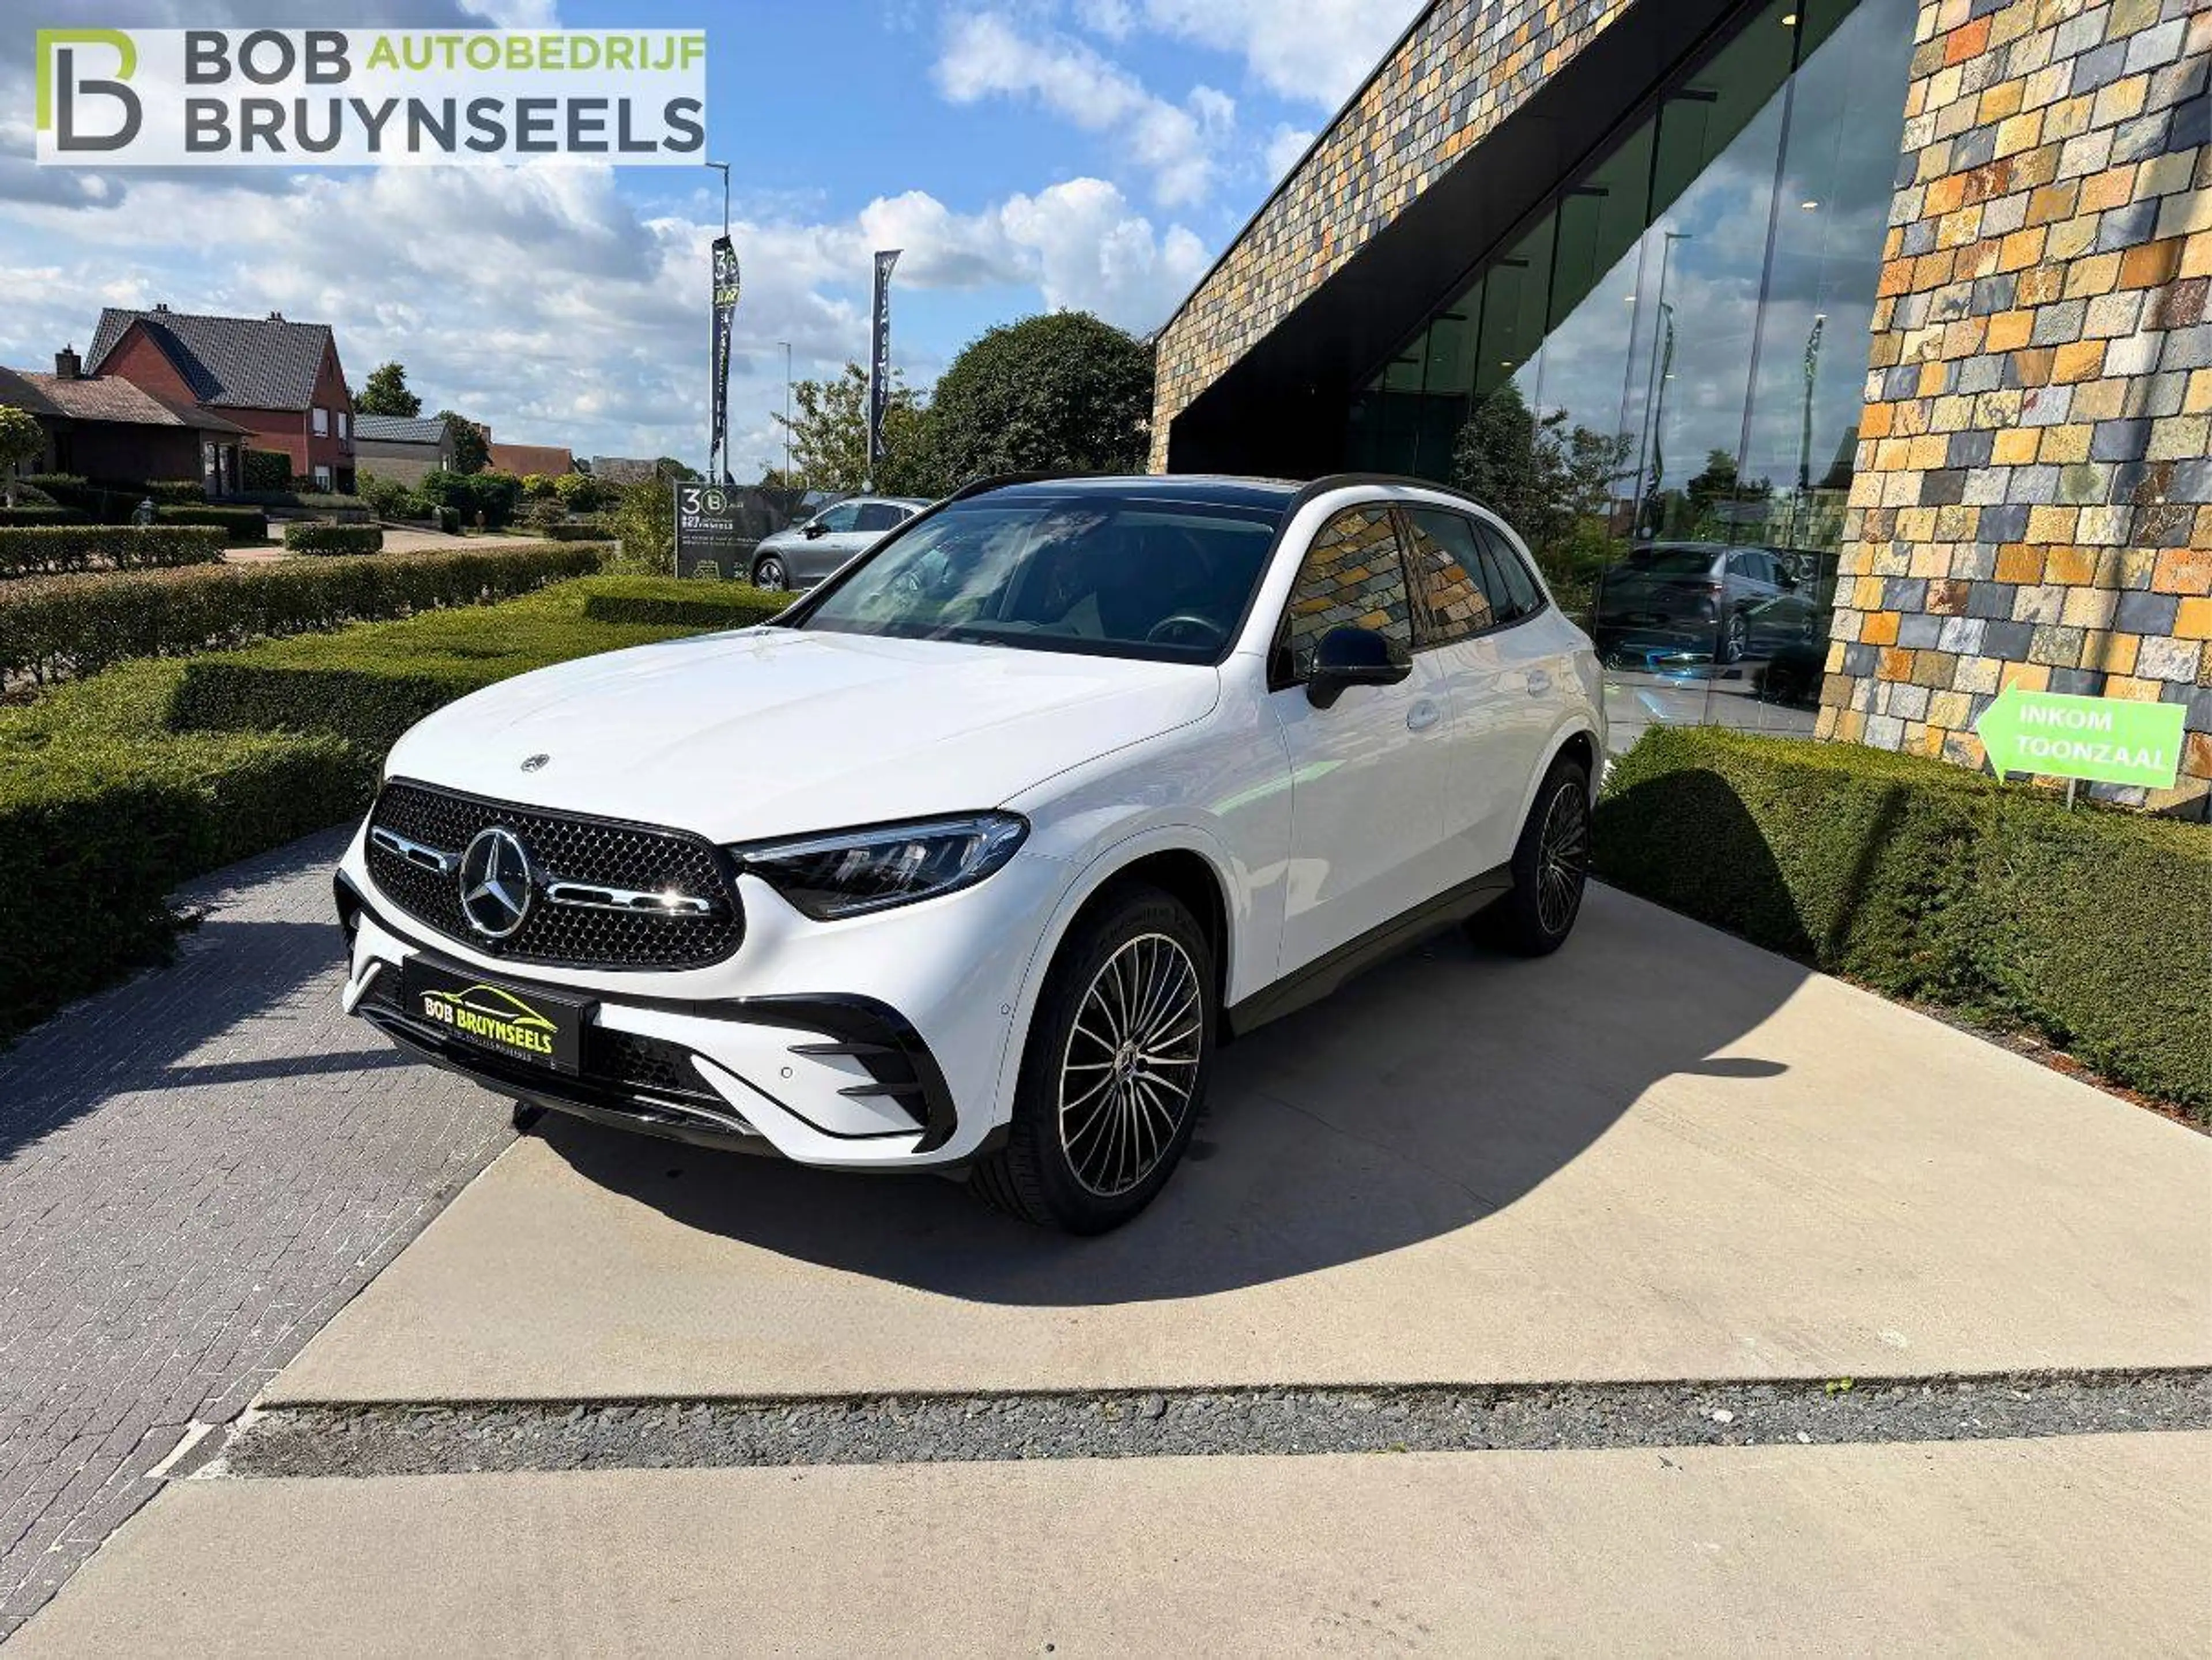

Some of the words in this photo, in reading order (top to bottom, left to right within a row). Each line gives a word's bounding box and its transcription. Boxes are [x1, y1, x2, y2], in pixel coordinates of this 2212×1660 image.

[2020, 704, 2112, 731] INKOM
[2017, 735, 2166, 770] TOONZAAL
[424, 997, 453, 1024] BOB
[457, 1008, 552, 1054] BRUYNSEELS
